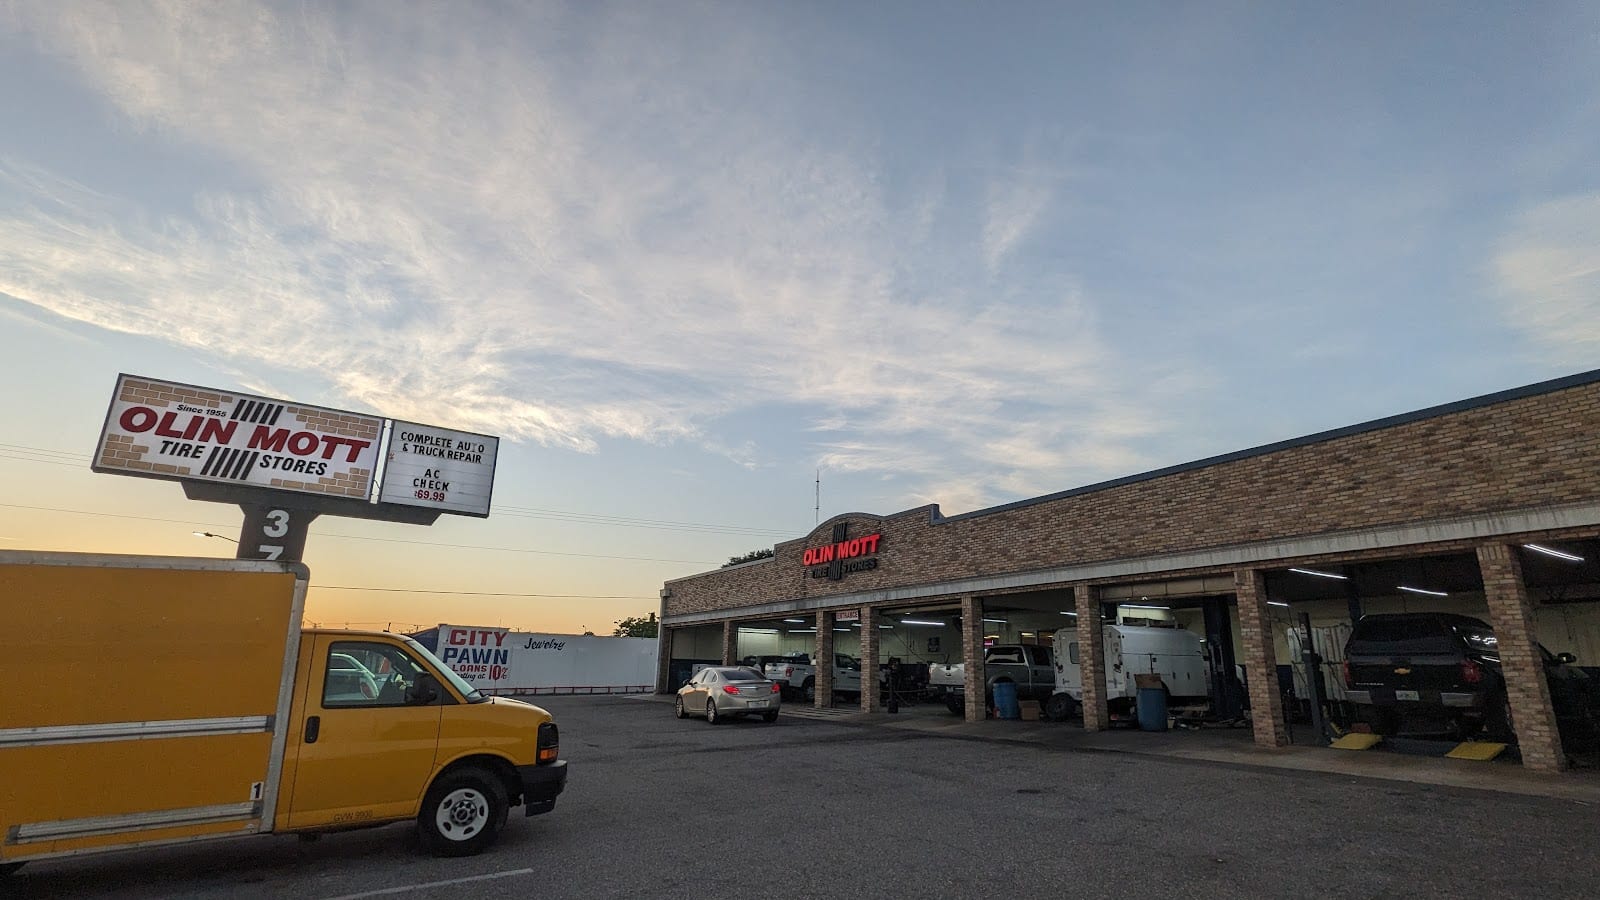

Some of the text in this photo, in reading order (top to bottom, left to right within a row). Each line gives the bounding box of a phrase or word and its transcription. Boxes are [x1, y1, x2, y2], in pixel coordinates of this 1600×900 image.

[176, 404, 228, 418] Since 1955
[119, 406, 371, 463] OLIN MOTT
[400, 431, 485, 453] COMPLETE AUTO
[159, 440, 328, 476] TIRE STORES
[402, 442, 482, 464] & TRUCK REPAIR
[413, 478, 450, 492] CHECK
[263, 509, 290, 538] 3
[803, 534, 880, 566] OLIN MOTT
[812, 558, 877, 579] TIRE STORES
[449, 629, 508, 647] CITY
[523, 637, 567, 651] Jewelry
[442, 647, 509, 665] PAWN
[452, 664, 508, 681] LOANS 10%
[253, 782, 262, 799] 1
